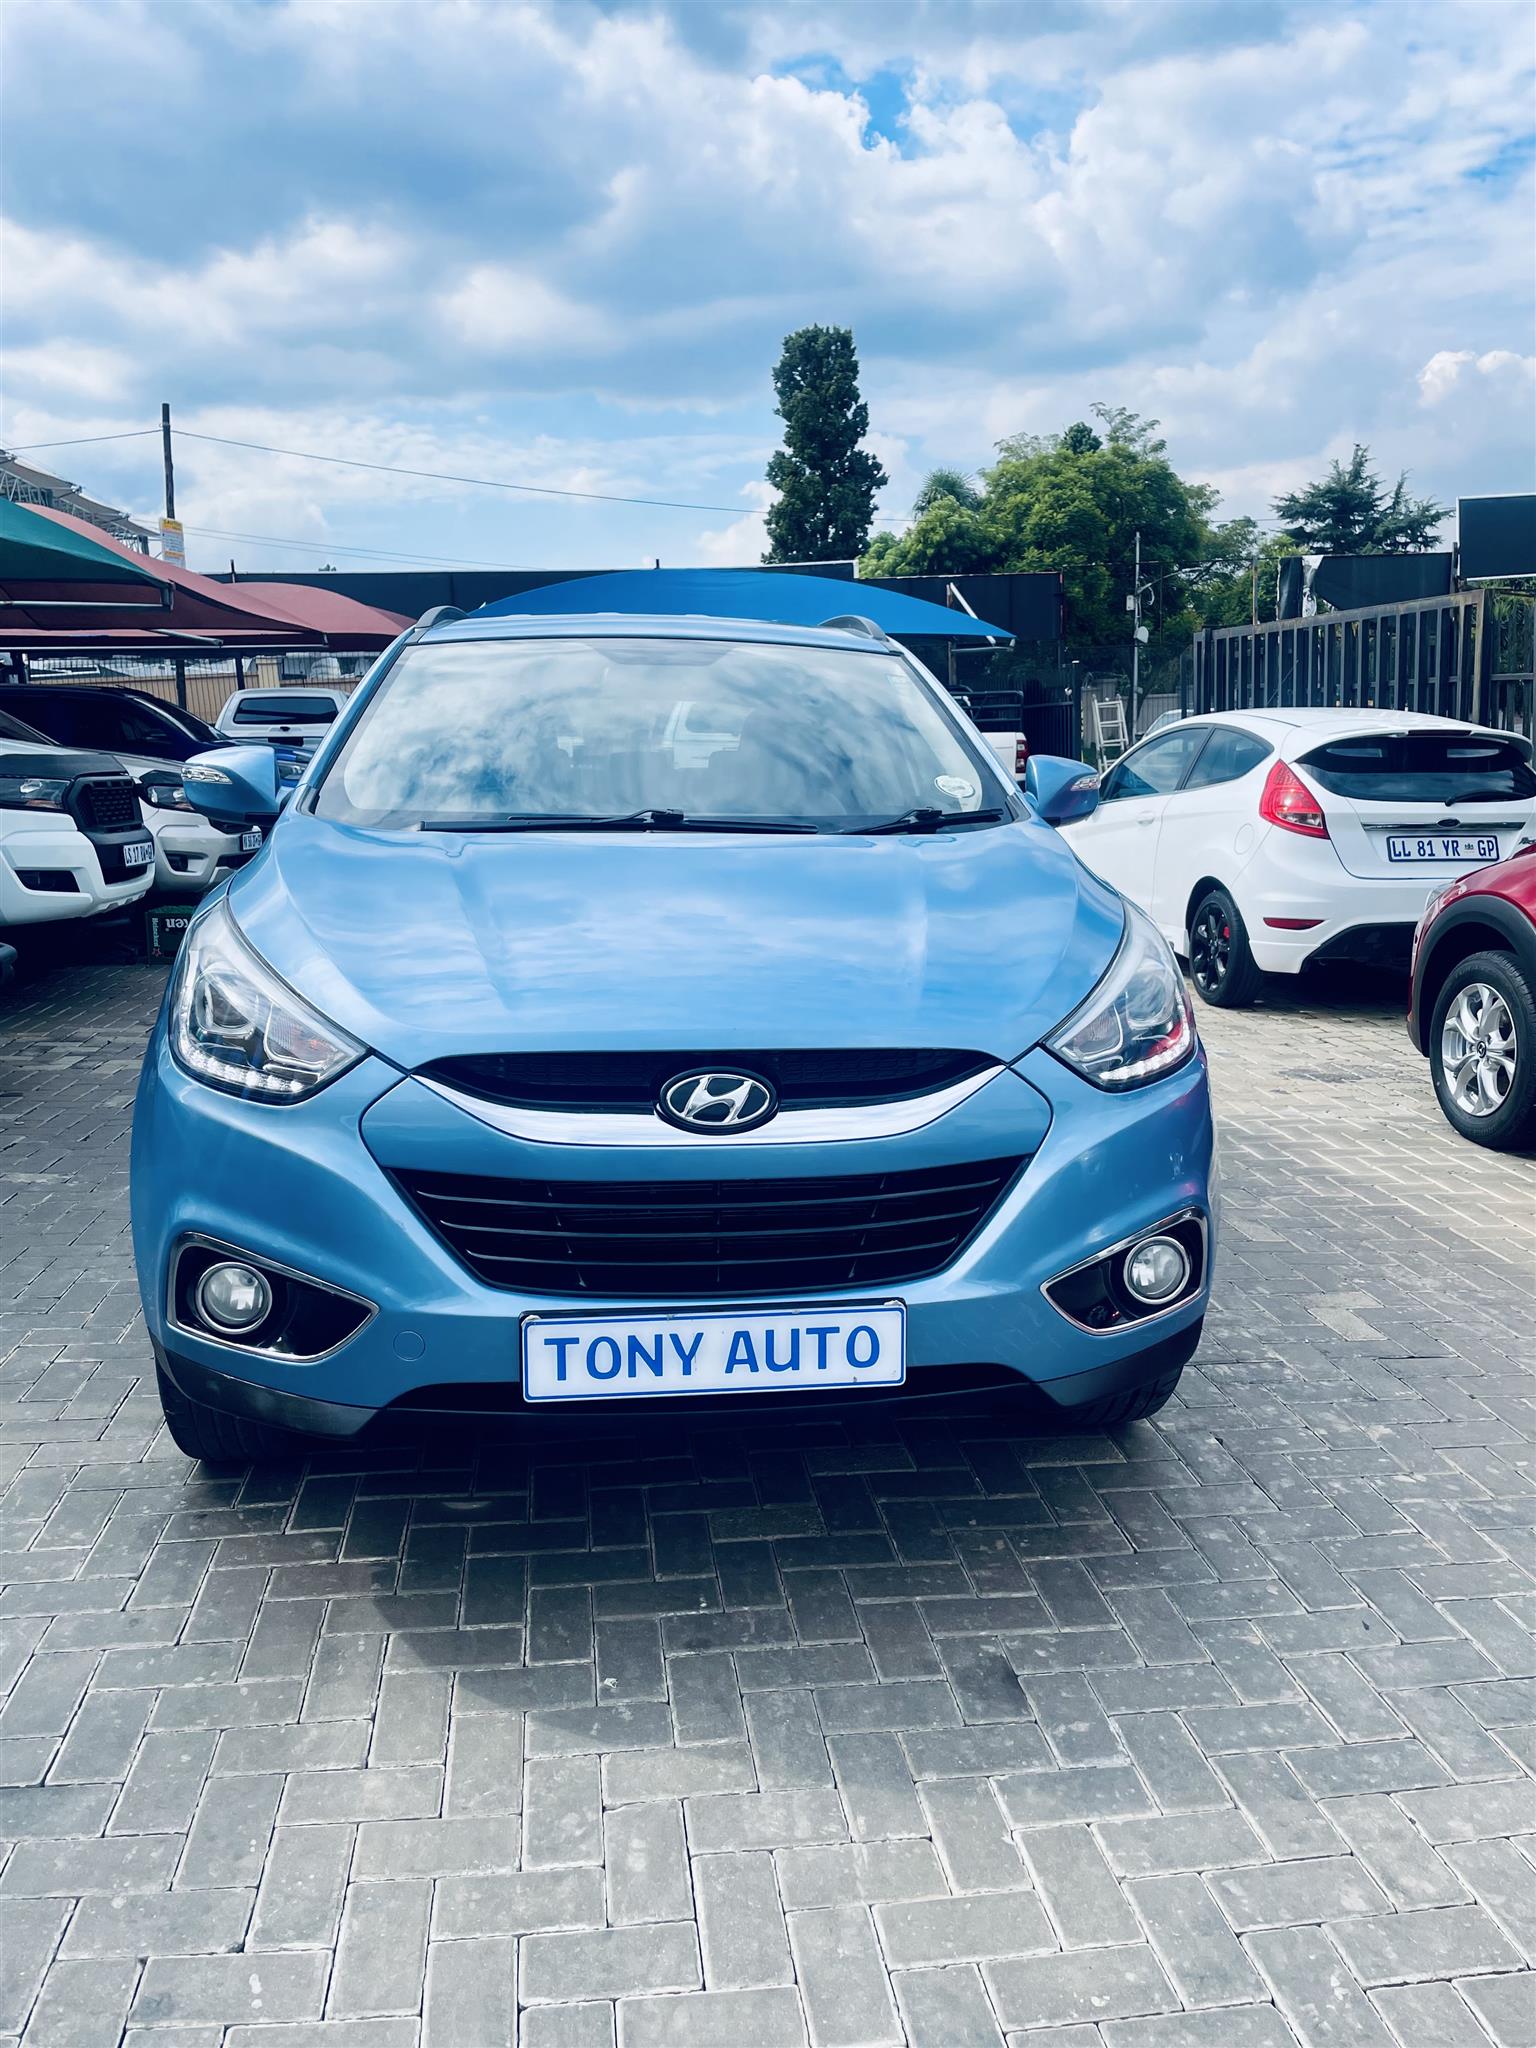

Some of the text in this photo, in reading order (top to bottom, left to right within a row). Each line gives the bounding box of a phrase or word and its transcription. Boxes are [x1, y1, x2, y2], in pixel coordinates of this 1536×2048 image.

[1392, 839, 1495, 857] LL 81 YR GP
[543, 1325, 880, 1381] TONY AUTO
